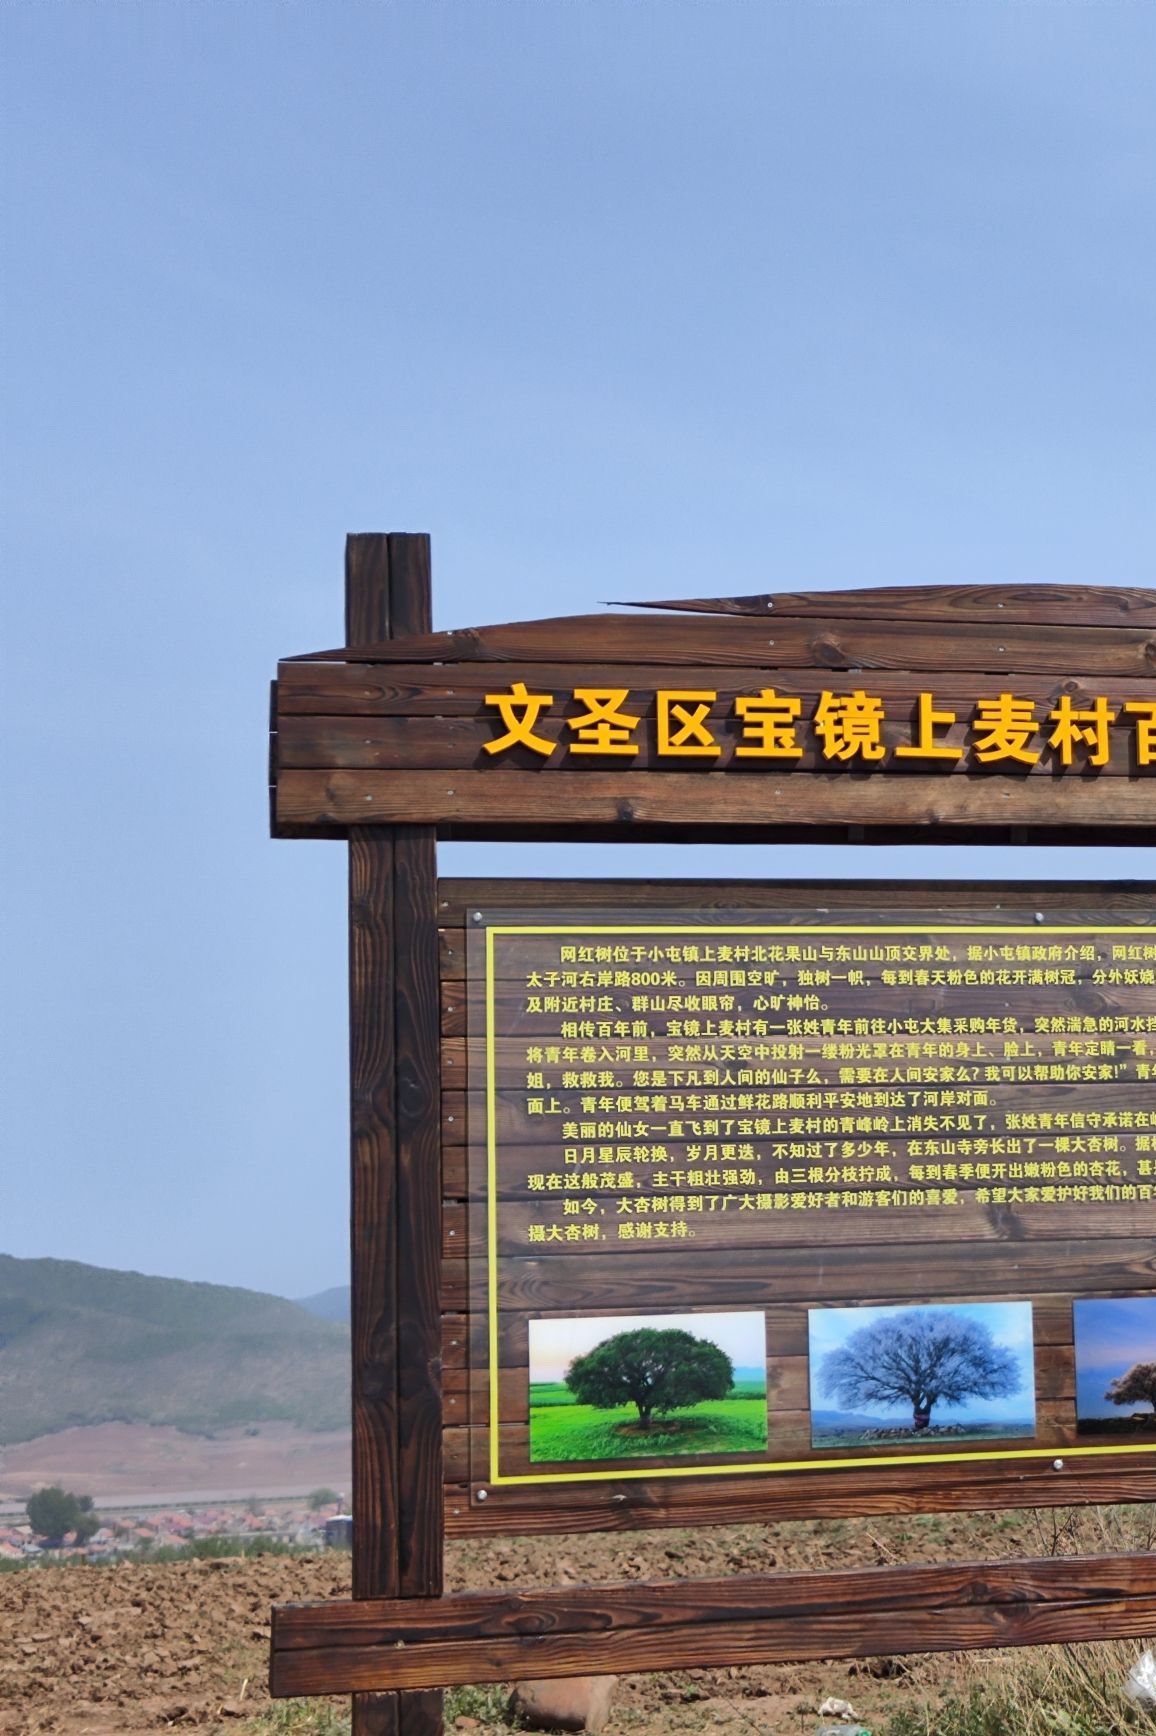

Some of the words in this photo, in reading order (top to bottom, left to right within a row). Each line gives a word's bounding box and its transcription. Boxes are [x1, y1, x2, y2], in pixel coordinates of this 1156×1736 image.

[527, 1220, 696, 1243] 摄大杏树，感谢支持。
